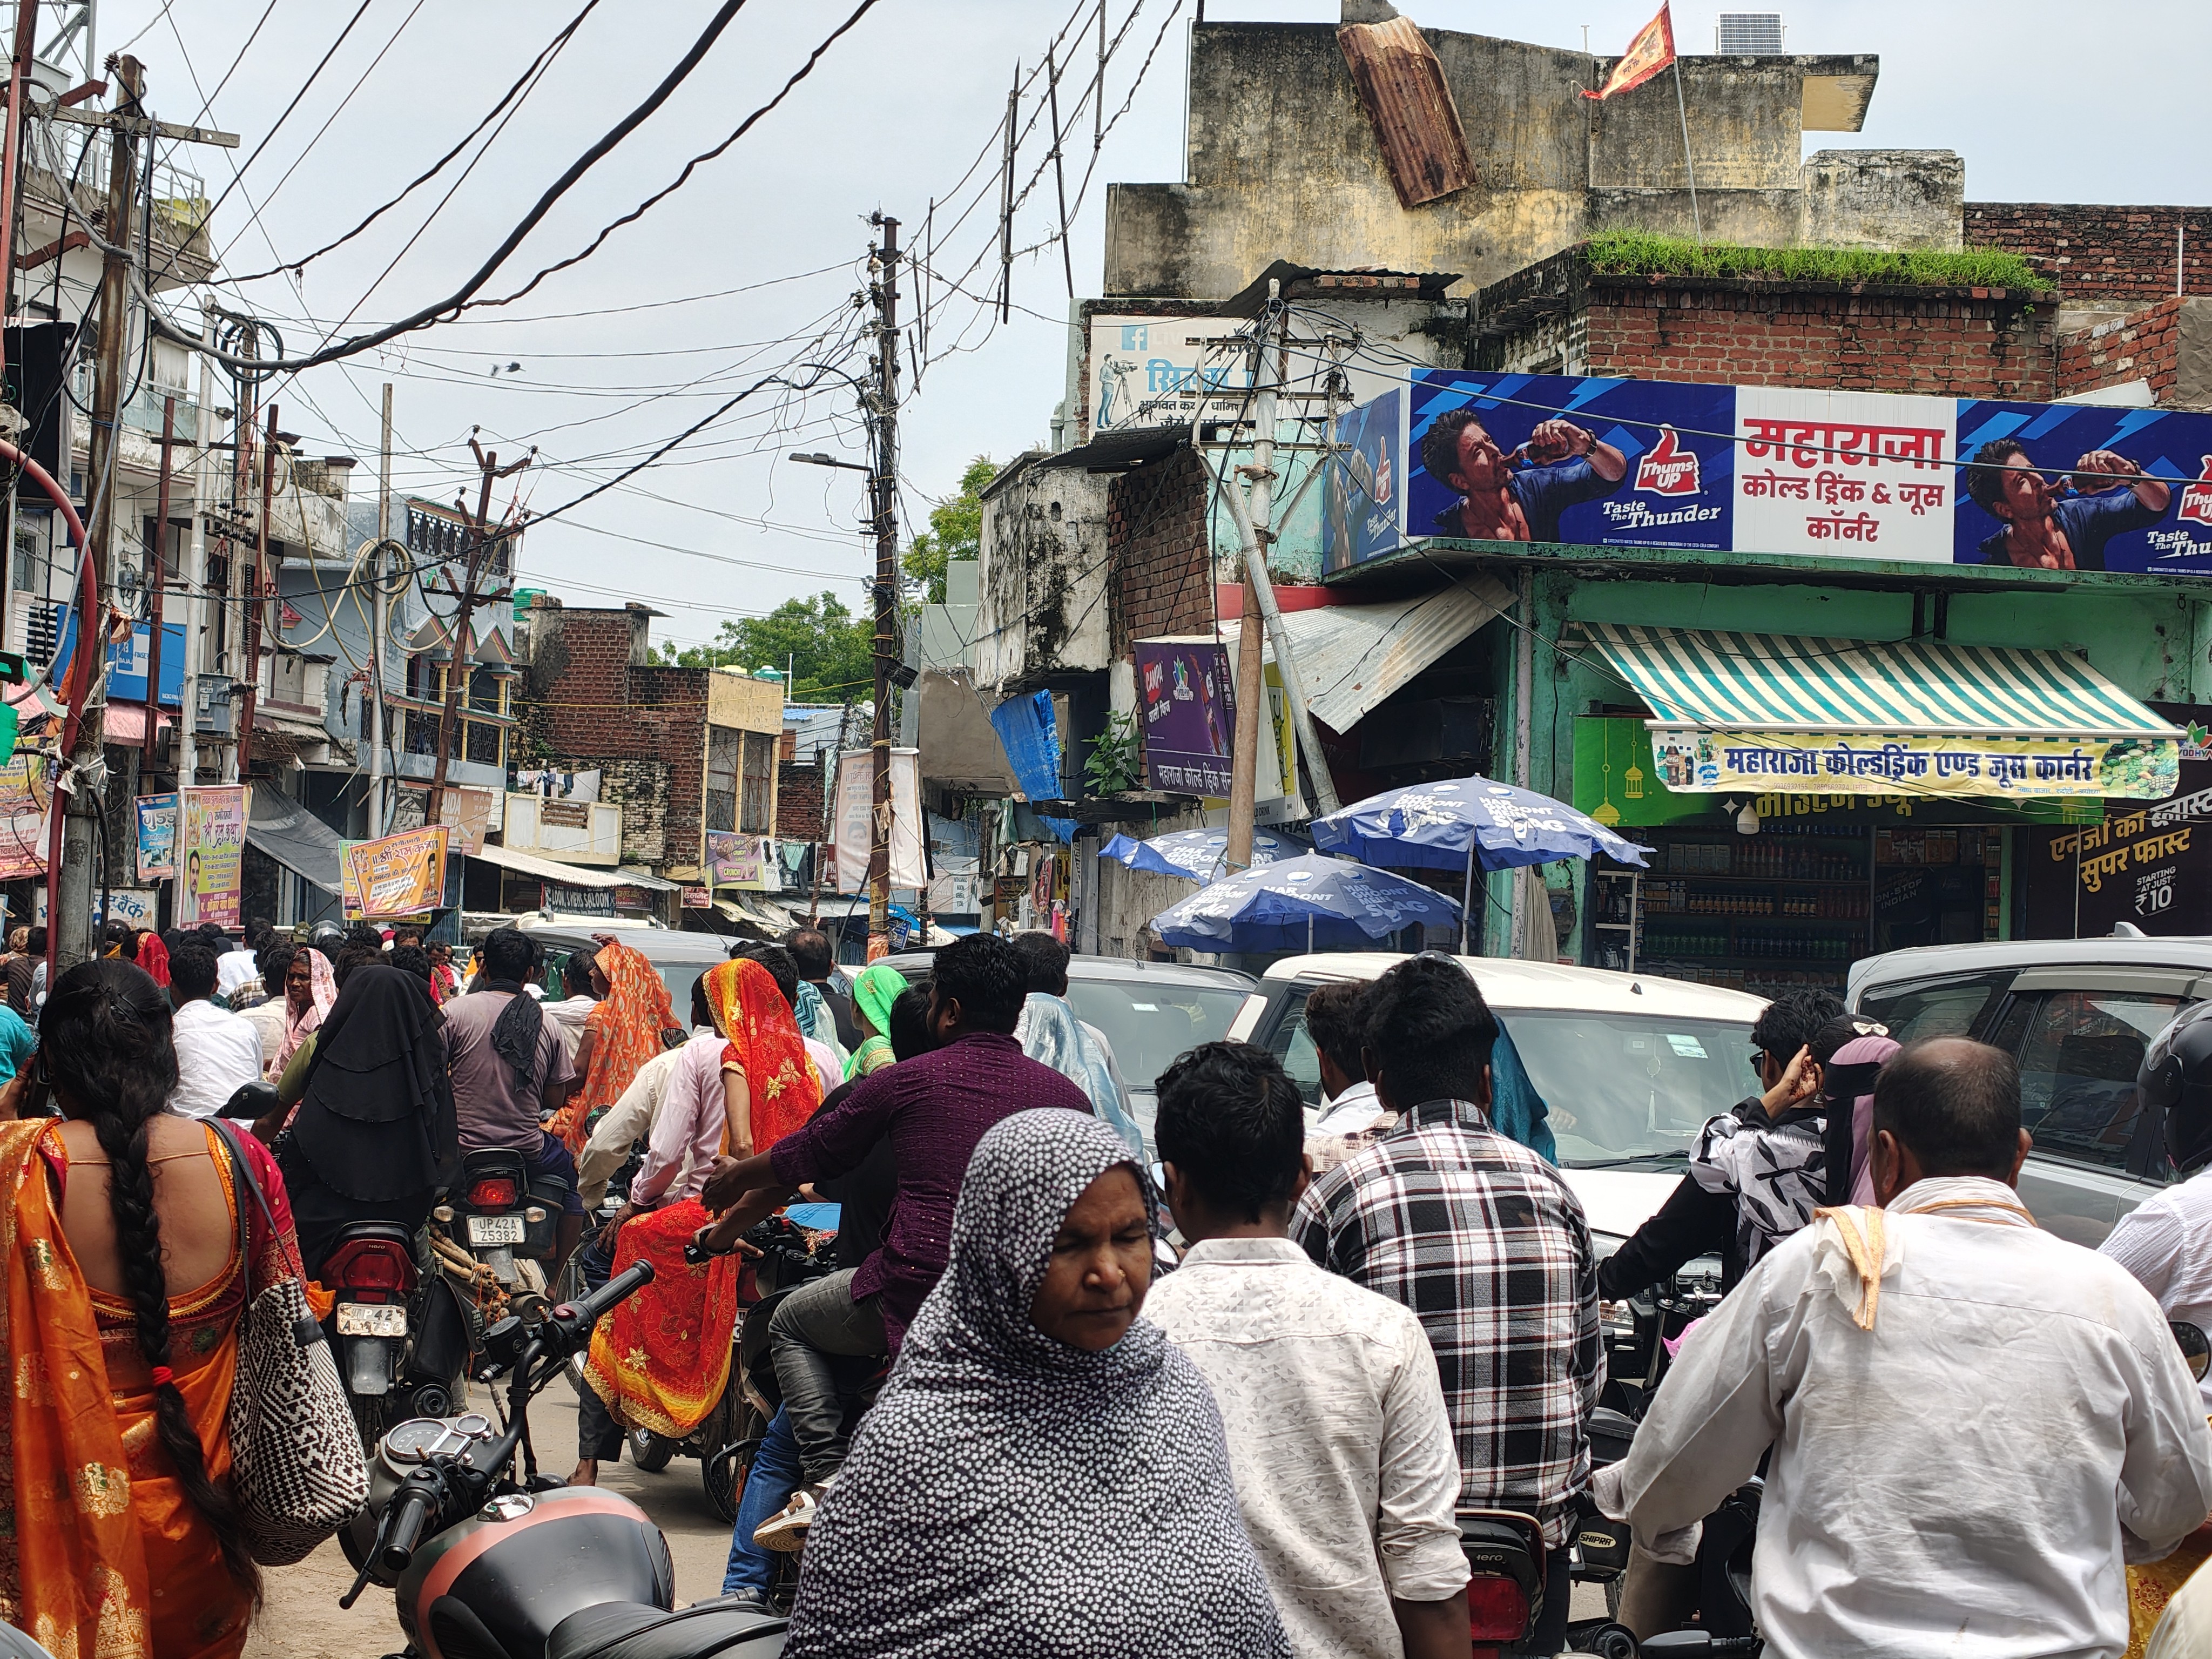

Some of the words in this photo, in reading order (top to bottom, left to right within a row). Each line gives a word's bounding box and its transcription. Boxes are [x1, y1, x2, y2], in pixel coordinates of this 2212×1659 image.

[1743, 418, 1946, 470] महाराजा
[1642, 461, 1695, 479] Thums
[1742, 468, 1810, 500] कोल्ड
[1815, 470, 1867, 505] ड्रिंक
[1871, 482, 1893, 504] &
[1898, 483, 1945, 516] जूस
[2186, 492, 2212, 509] Thu
[1603, 500, 1646, 515] Taste
[1610, 513, 1627, 521] The
[1627, 503, 1722, 529] Thunder
[1806, 509, 1880, 542] कॉर्नर
[2147, 529, 2189, 544] Taste
[1146, 662, 1164, 692] CAMPA
[1157, 764, 1183, 787] महाराजा
[1183, 760, 1203, 788] कोल्ड
[1203, 761, 1219, 794] ड्रिंक
[1724, 748, 1819, 774] महाराजा
[1934, 752, 1981, 777] एण्ड
[1986, 754, 2028, 788] जूस
[2032, 748, 2094, 781] कार्नर
[1483, 804, 1554, 815] GHOONT
[2114, 811, 2147, 838] का
[1167, 852, 1217, 862] GHOON
[2080, 846, 2130, 893] सुपर
[2133, 827, 2192, 864] फास्ट
[2136, 866, 2176, 886] STARTING
[2141, 881, 2151, 893] AT
[2151, 876, 2171, 890] JUST
[1351, 888, 1411, 898] GHOONT
[1875, 878, 1923, 902] ON-STOP
[117, 894, 146, 918] बैंक
[480, 1230, 518, 1242] Z5382
[1580, 1534, 1613, 1546] SHIPRA
